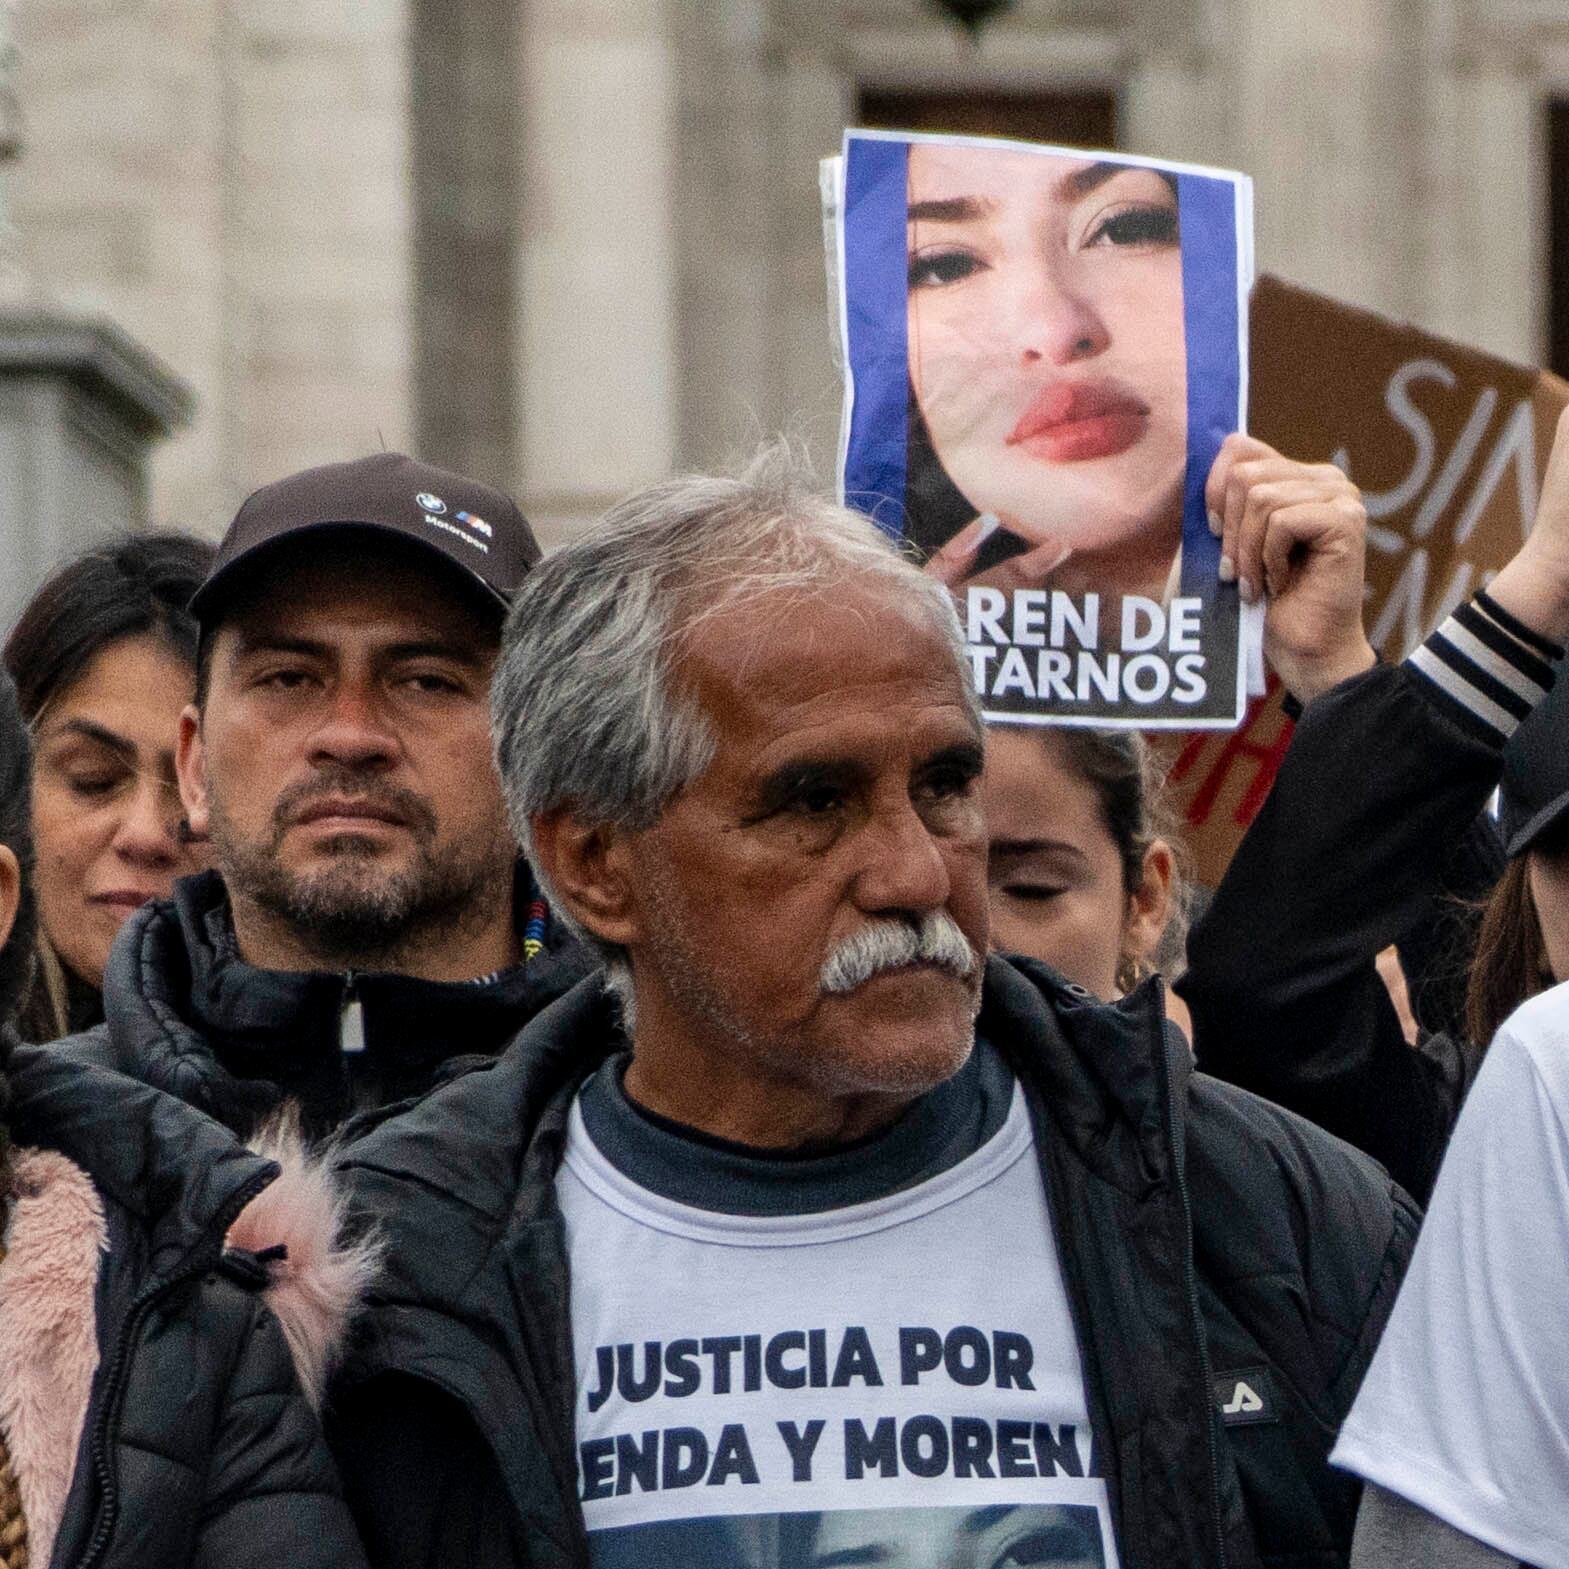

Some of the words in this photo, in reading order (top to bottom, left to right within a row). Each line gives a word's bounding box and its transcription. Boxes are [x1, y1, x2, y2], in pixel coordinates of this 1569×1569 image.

[425, 515, 488, 554] Motorsport
[1120, 594, 1203, 653] DE
[587, 1326, 884, 1411] JUSTICIA
[898, 1325, 1037, 1392] POR
[776, 1418, 827, 1483] Y
